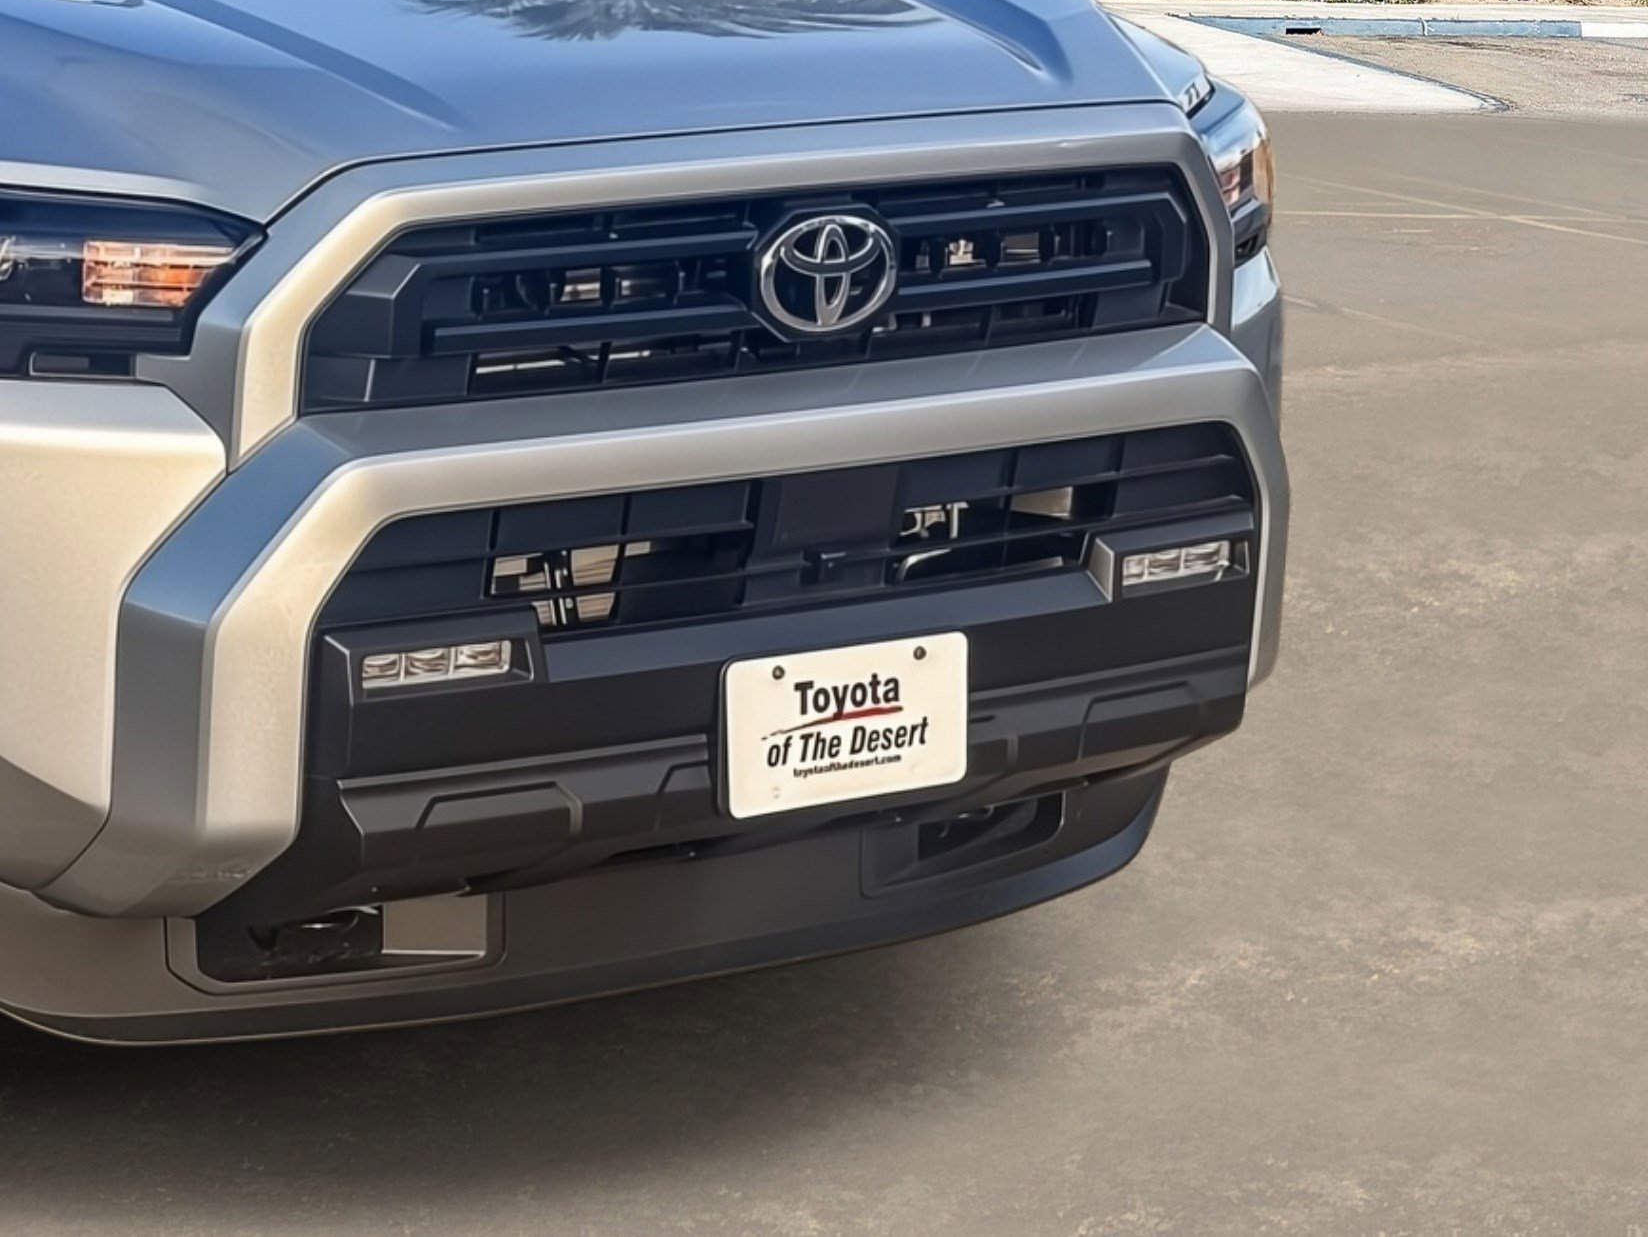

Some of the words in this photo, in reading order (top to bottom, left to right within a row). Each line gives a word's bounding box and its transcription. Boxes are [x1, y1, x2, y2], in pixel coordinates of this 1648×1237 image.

[793, 673, 901, 721] Toyota
[767, 735, 793, 768] of
[799, 730, 843, 763] The
[849, 716, 930, 755] Desert
